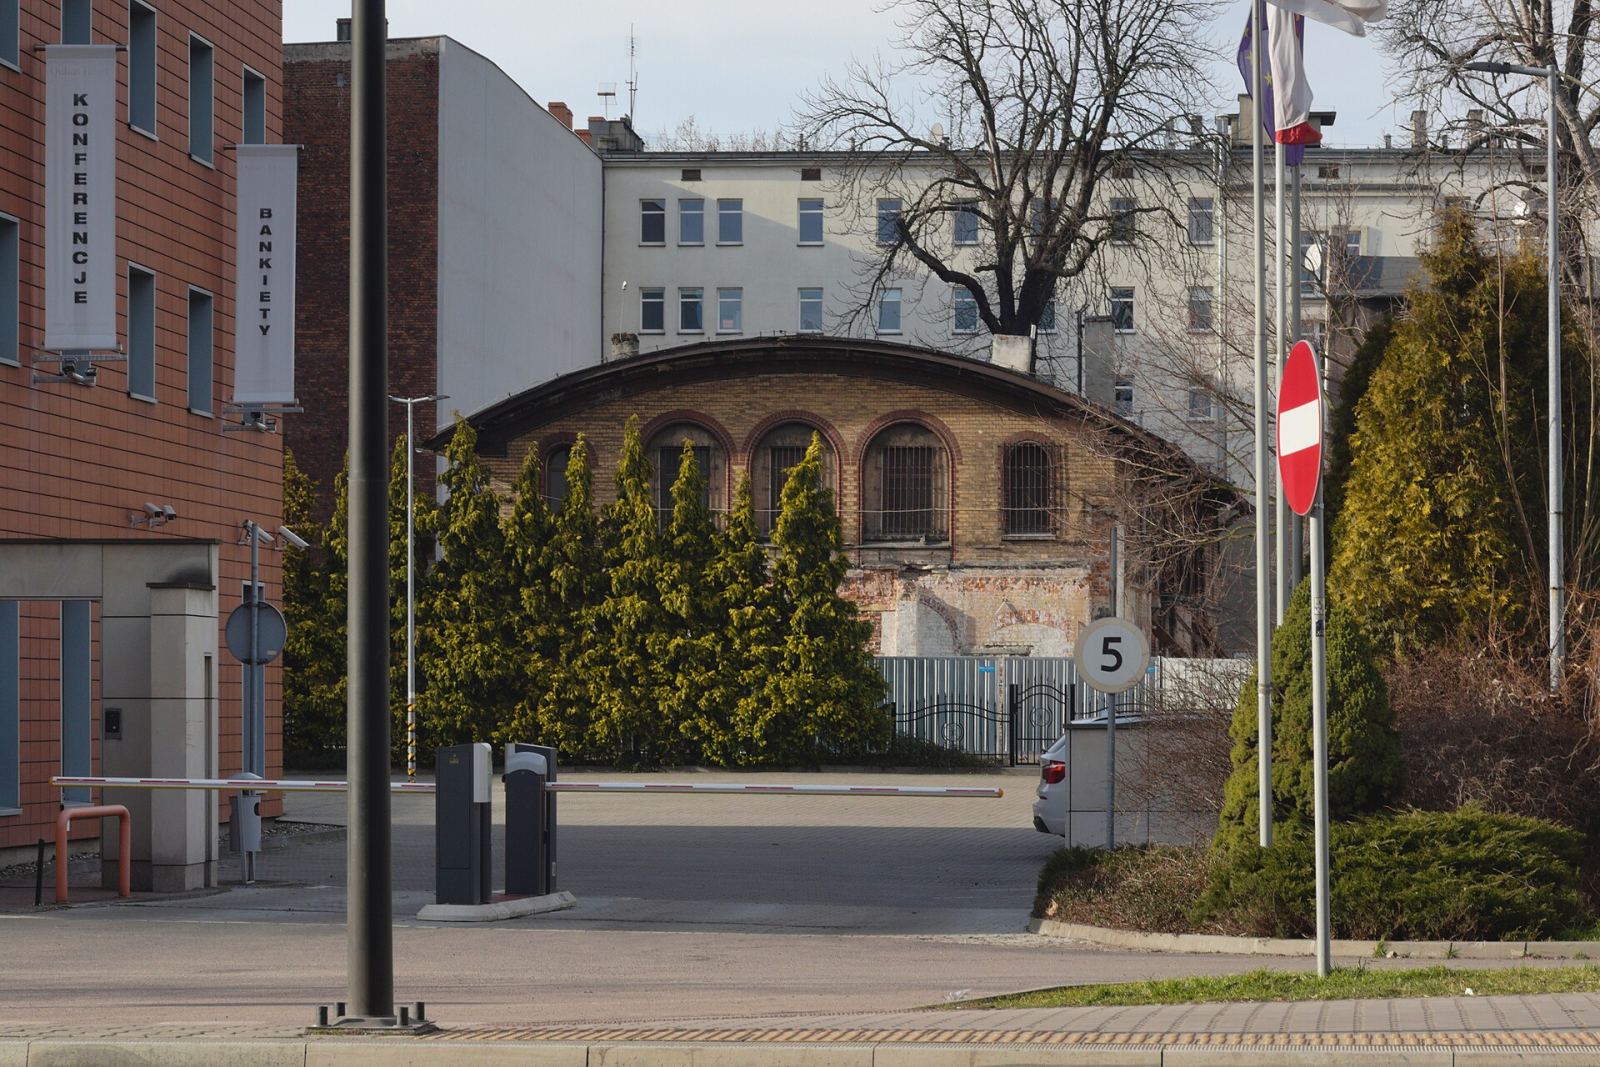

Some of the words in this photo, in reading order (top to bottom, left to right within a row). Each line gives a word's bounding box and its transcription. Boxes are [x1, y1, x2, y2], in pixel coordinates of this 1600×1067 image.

[72, 93, 89, 304] KONFERENCJE
[258, 208, 273, 336] BANKIETY
[1100, 636, 1122, 672] 5
